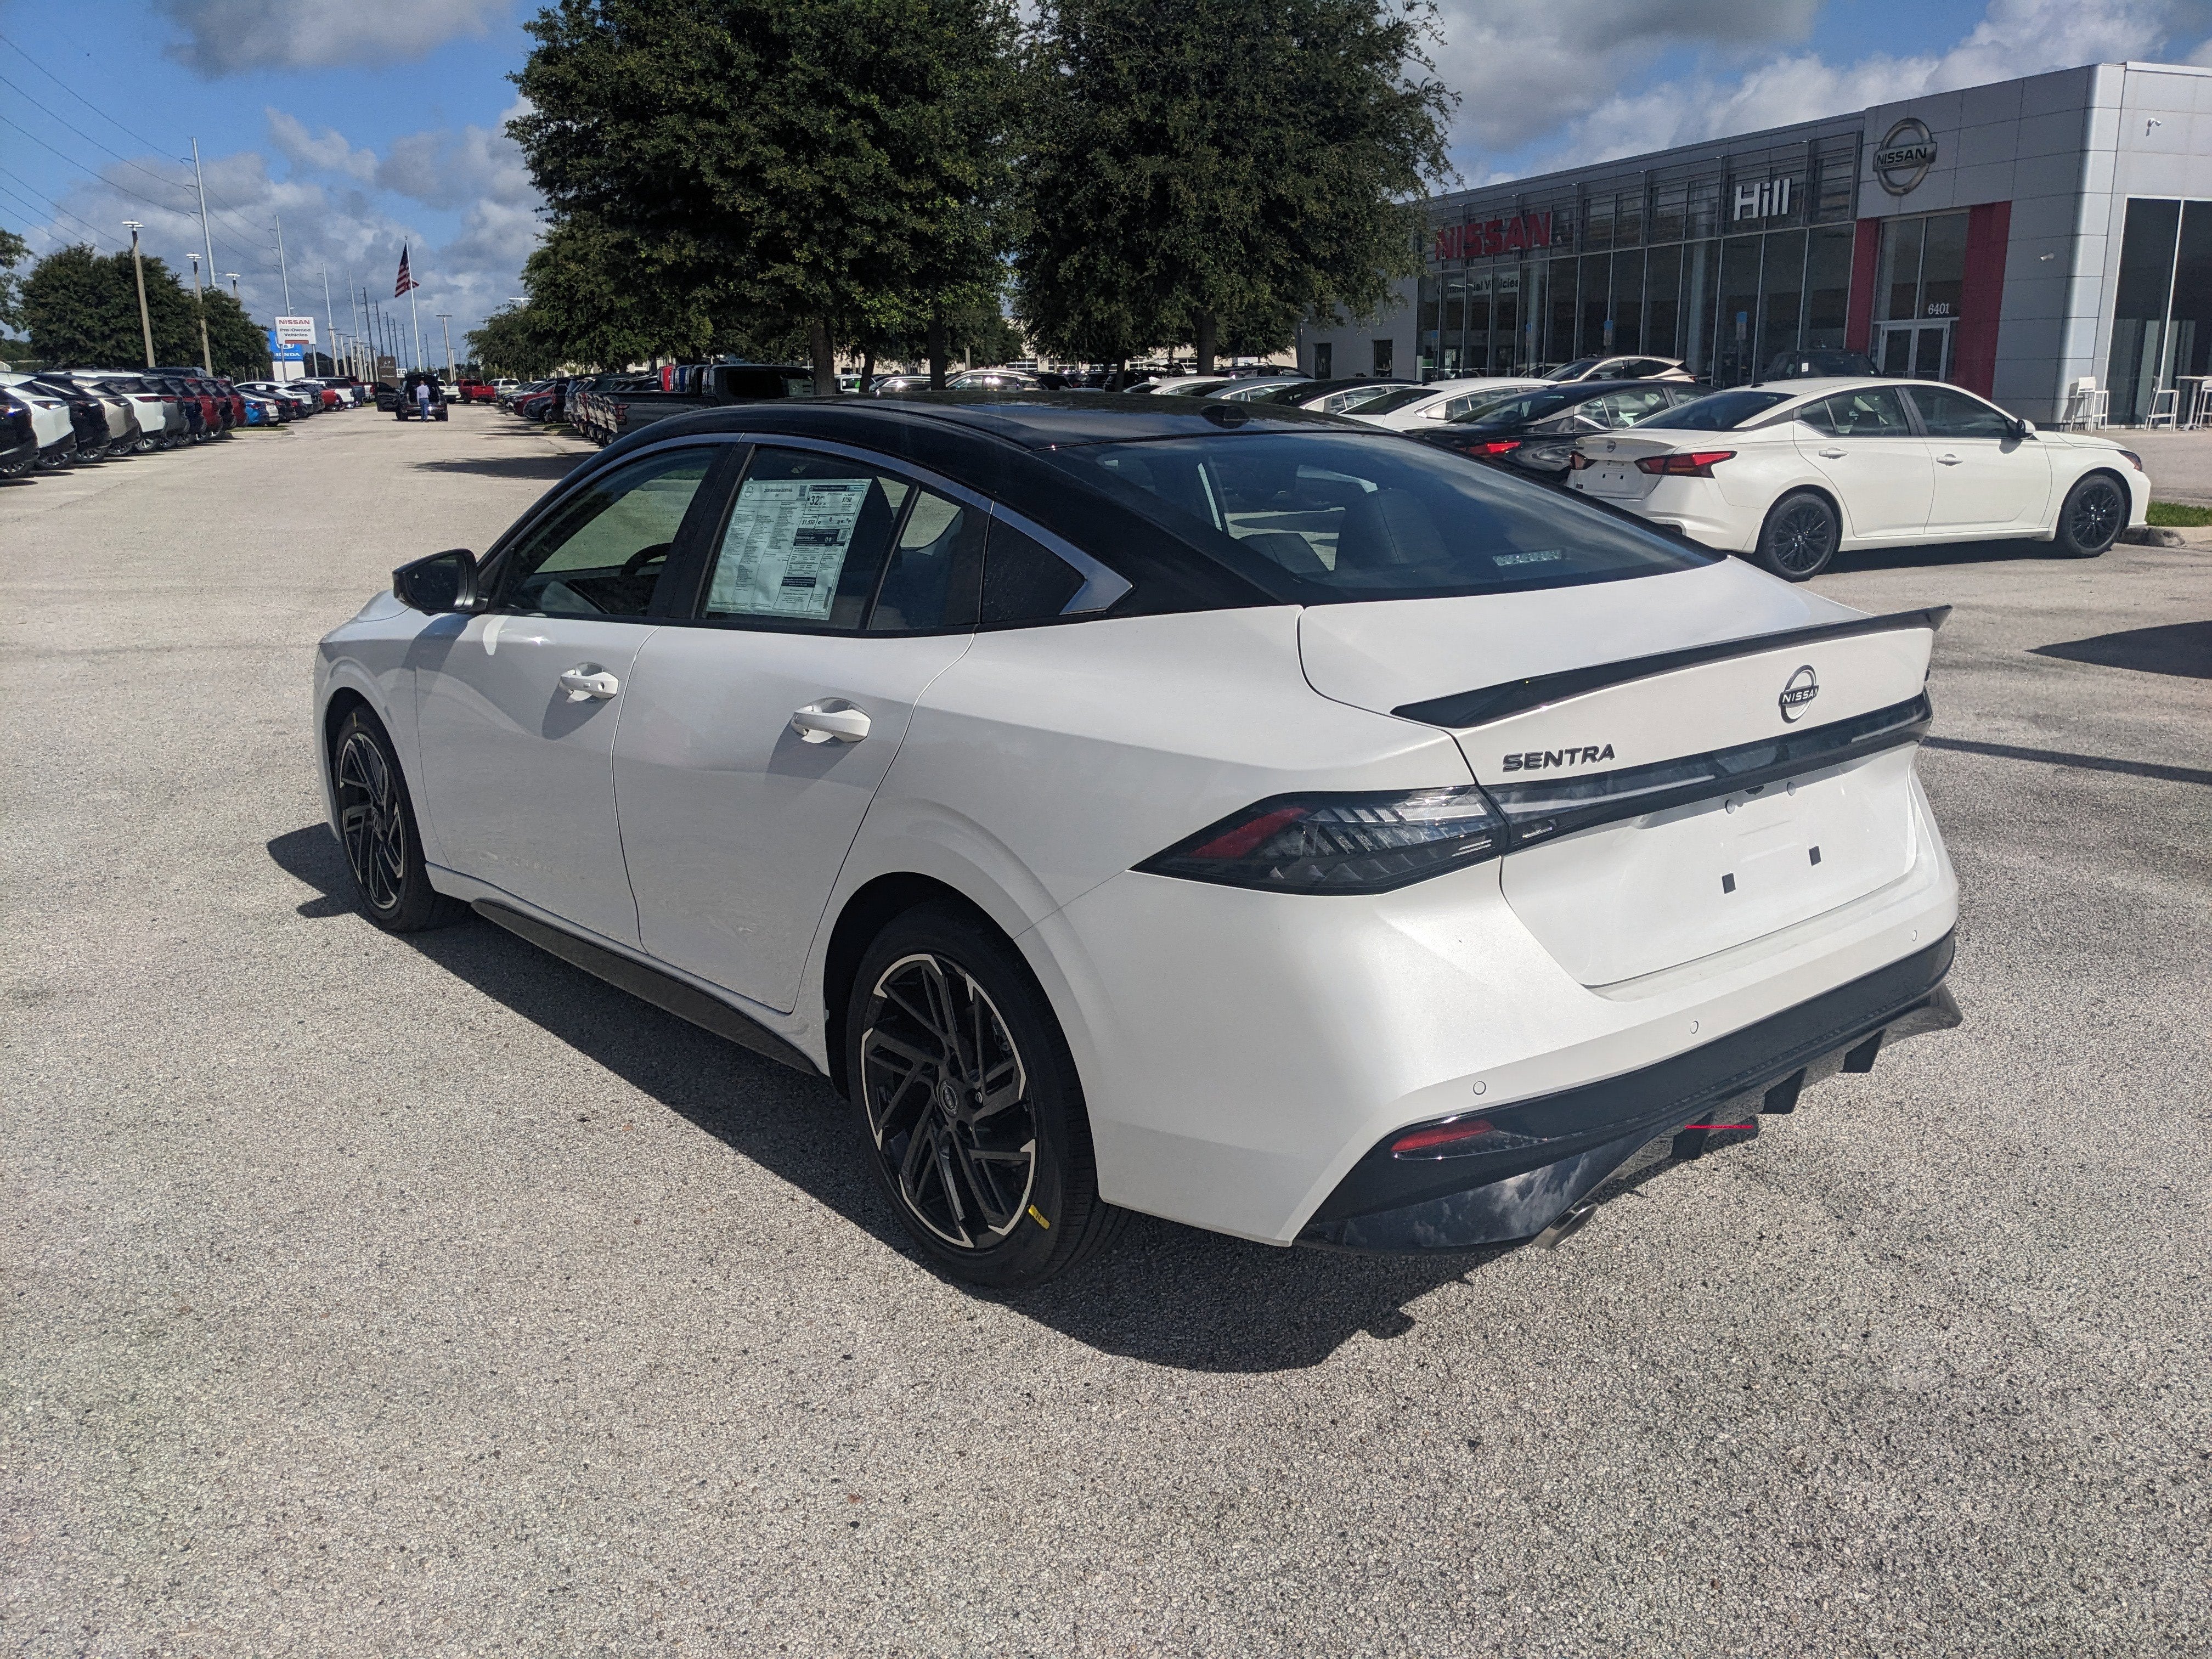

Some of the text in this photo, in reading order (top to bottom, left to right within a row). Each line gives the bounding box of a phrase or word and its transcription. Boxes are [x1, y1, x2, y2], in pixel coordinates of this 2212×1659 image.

[1877, 148, 1927, 166] NISSAN
[1734, 178, 1792, 221] Hill
[1435, 211, 1551, 261] NISSAN
[1928, 302, 1950, 315] 6401
[810, 495, 820, 506] 32
[1782, 688, 1818, 703] NISSAN
[1502, 743, 1616, 772] SENTRA
